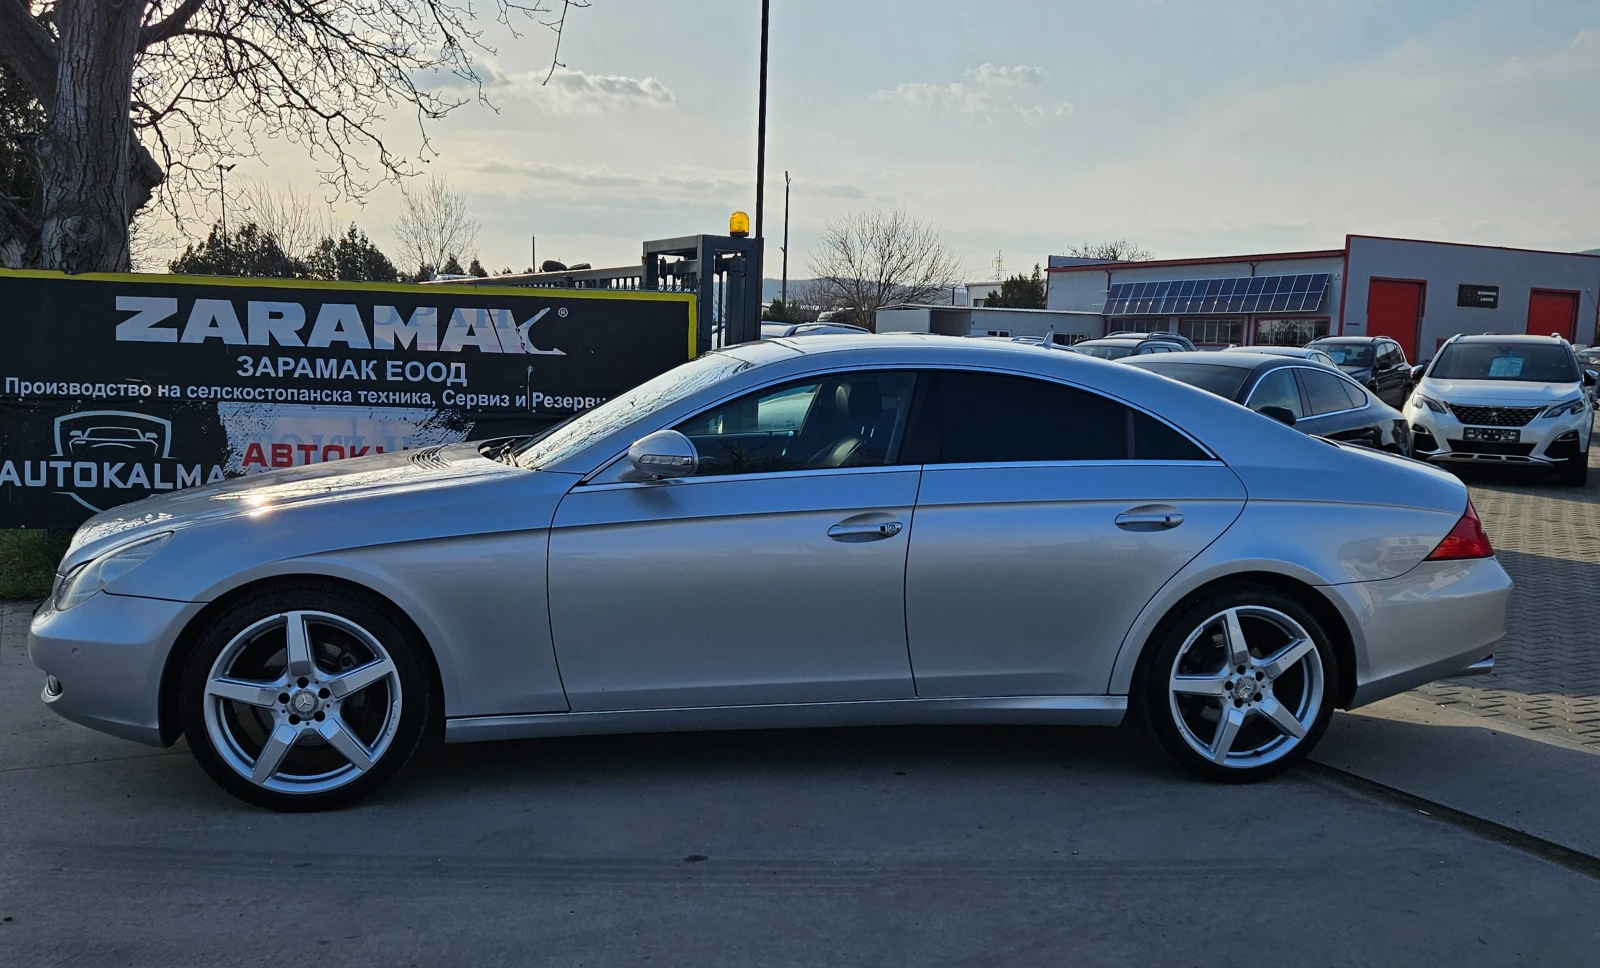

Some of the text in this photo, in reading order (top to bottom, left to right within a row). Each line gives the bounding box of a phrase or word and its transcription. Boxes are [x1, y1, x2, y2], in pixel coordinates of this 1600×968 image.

[115, 295, 567, 356] ZARAMAK
[236, 355, 468, 387] ЗАРАМАК ЕООД
[5, 376, 152, 399] Производство
[157, 384, 181, 398] на
[186, 384, 352, 403] селскостопанска
[357, 390, 436, 407] техника,
[442, 389, 510, 409] Сервиз
[515, 395, 526, 407] и
